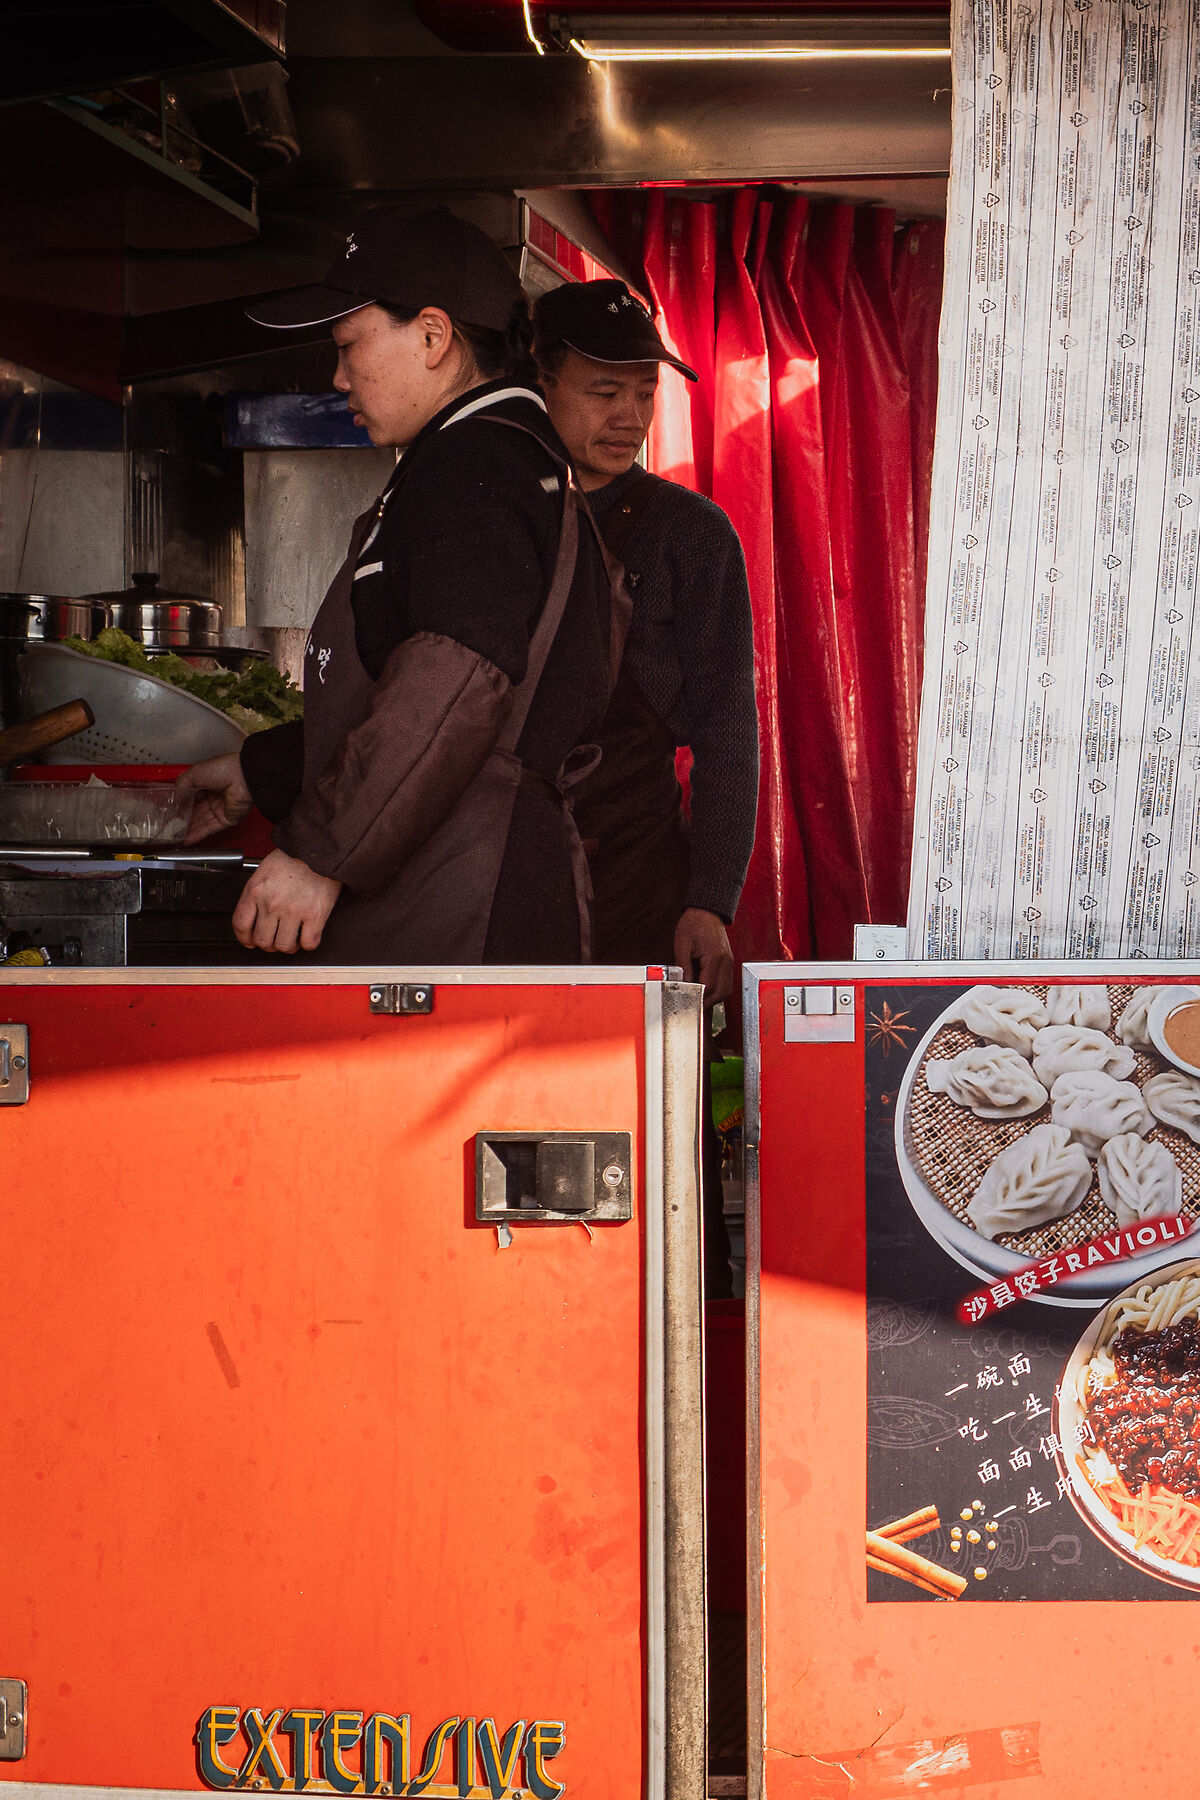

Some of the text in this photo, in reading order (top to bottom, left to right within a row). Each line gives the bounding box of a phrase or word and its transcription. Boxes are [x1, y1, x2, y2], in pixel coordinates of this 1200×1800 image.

[1164, 759, 1174, 815] GARANTIESTREIFEN
[964, 1218, 1185, 1322] 沙县饺子 RAVIOLI
[944, 1352, 1031, 1396] 一碗面
[977, 1419, 1096, 1484] 面面俱到
[198, 1706, 566, 1799] EXTENSIVE
